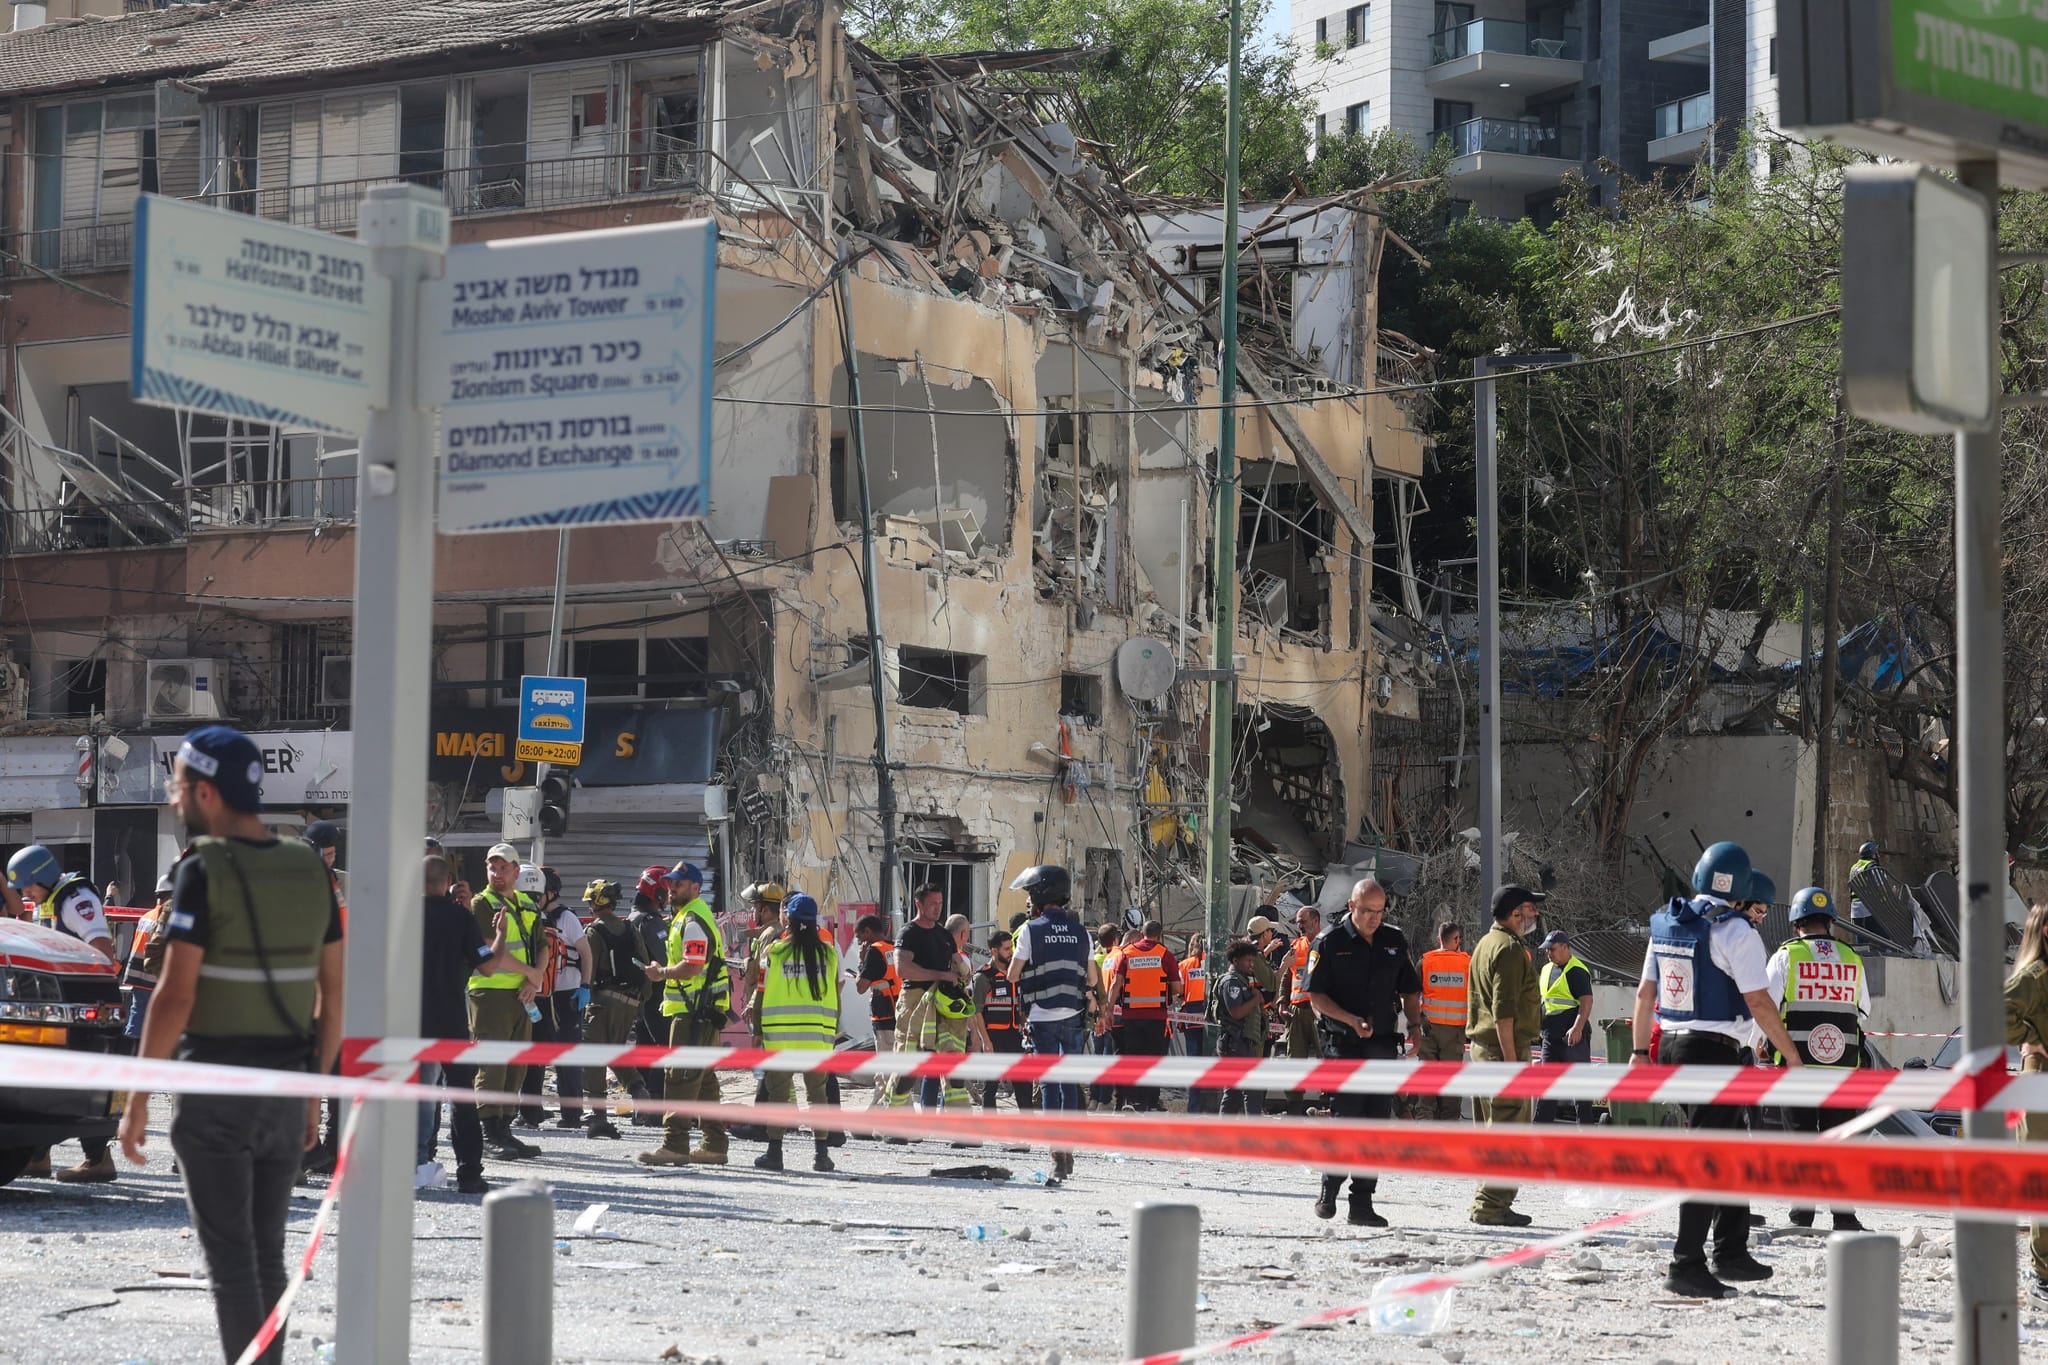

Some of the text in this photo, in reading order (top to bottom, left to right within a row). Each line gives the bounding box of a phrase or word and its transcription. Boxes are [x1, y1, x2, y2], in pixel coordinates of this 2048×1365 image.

[240, 238, 364, 281] רחוב היוזמה
[309, 275, 363, 304] Street
[453, 266, 639, 302] מגדל משה אביב
[184, 302, 247, 332] סילבר
[452, 295, 629, 328] Moshe Aviv Tower
[252, 311, 291, 342] הלל
[298, 324, 340, 351] אבא
[201, 333, 244, 358] Abba
[249, 342, 291, 367] Hillel
[294, 350, 341, 376] Silver
[493, 344, 582, 371] הציונות
[591, 340, 642, 364] כיכר
[451, 374, 525, 400] Zionism
[530, 371, 600, 398] Square
[449, 419, 552, 448] היהלומים
[559, 415, 631, 439] בורסת
[448, 442, 632, 473] Diamond Exchange
[436, 732, 505, 758] MAGI
[519, 744, 577, 760] 05:00 22:00
[1044, 935, 1078, 944] ההנדסה
[1051, 924, 1069, 934] אגף
[1798, 961, 1857, 982] חובש
[1798, 983, 1856, 1002] הצלה
